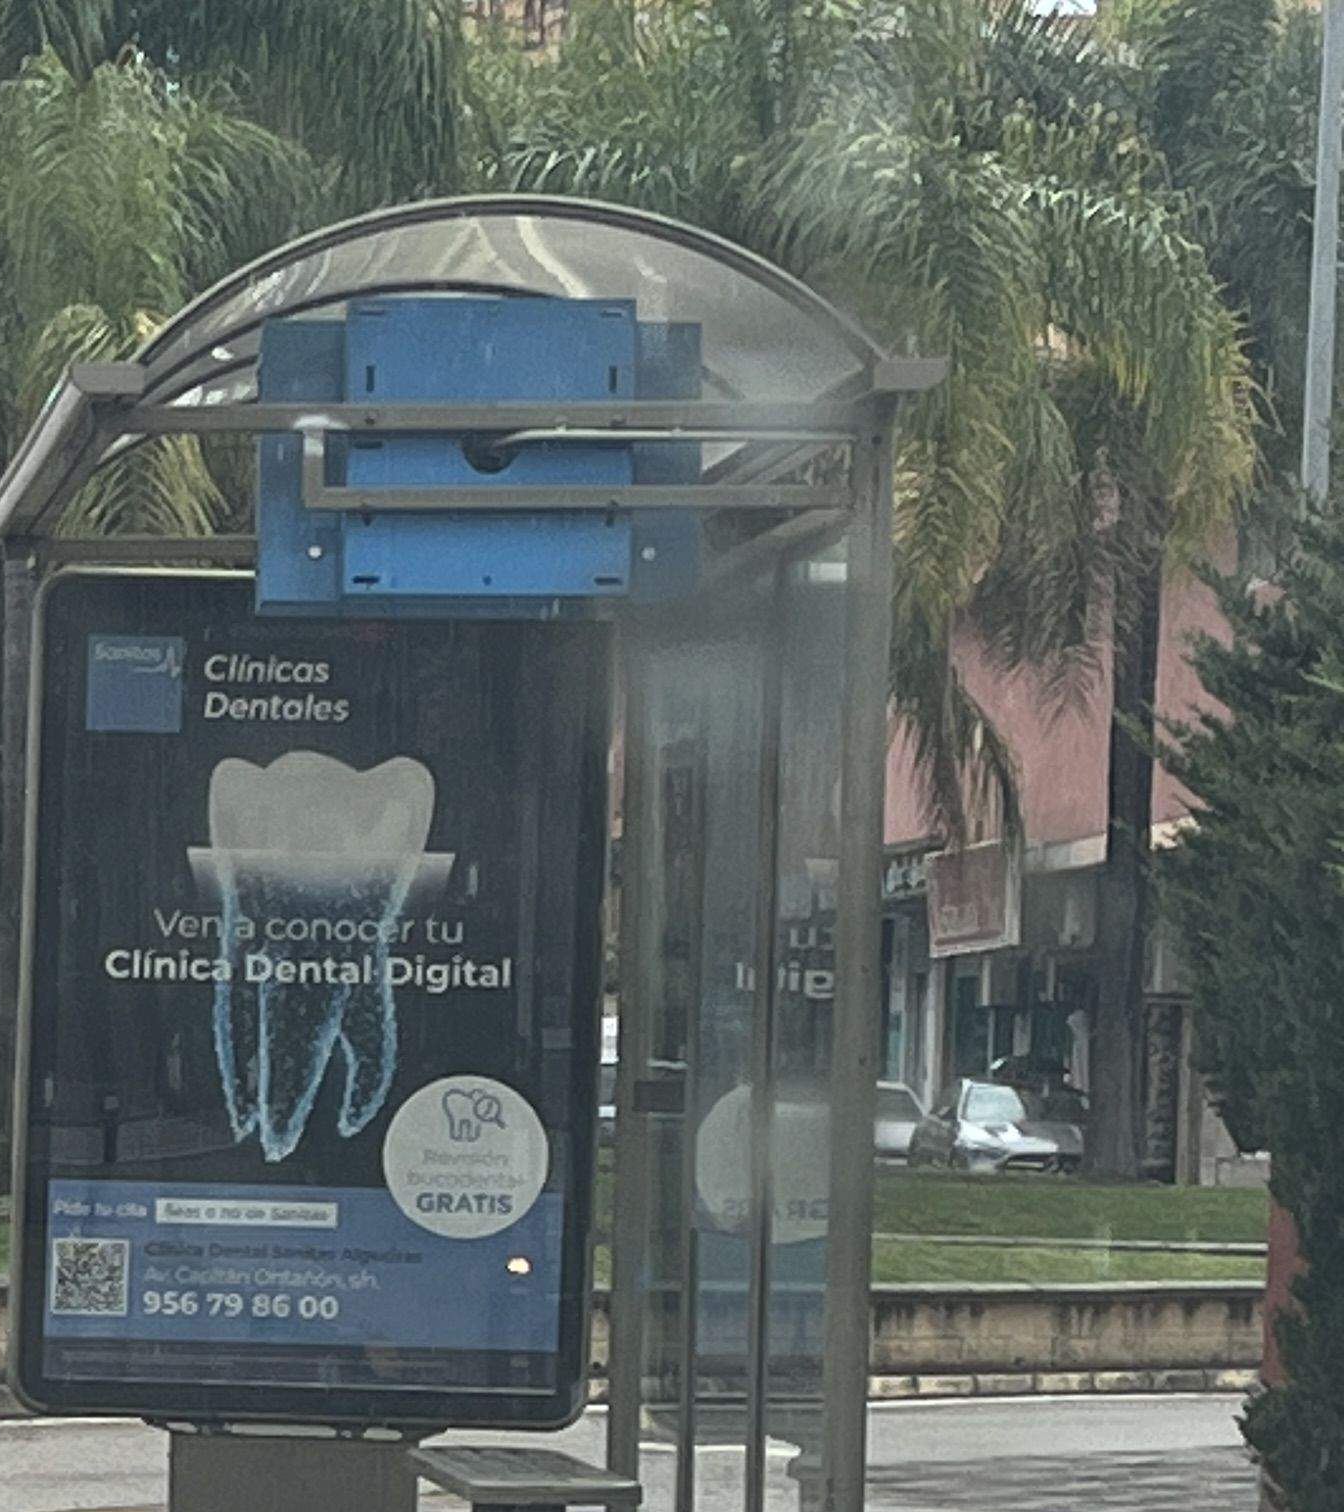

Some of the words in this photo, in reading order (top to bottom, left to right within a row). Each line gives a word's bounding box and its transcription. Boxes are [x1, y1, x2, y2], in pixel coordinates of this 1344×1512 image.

[204, 654, 330, 683] Clínicas
[204, 692, 350, 722] Dentales
[153, 909, 224, 939] Ven
[235, 918, 256, 940] a
[265, 917, 415, 944] conocer
[426, 914, 464, 944] tu
[105, 948, 233, 982] Clínica
[245, 953, 373, 984] Dental
[384, 954, 512, 994] Digital
[416, 1192, 513, 1215] GRATIS
[143, 1290, 199, 1316] 956
[206, 1292, 244, 1317] 79
[252, 1293, 291, 1318] 86
[298, 1295, 340, 1320] 00
